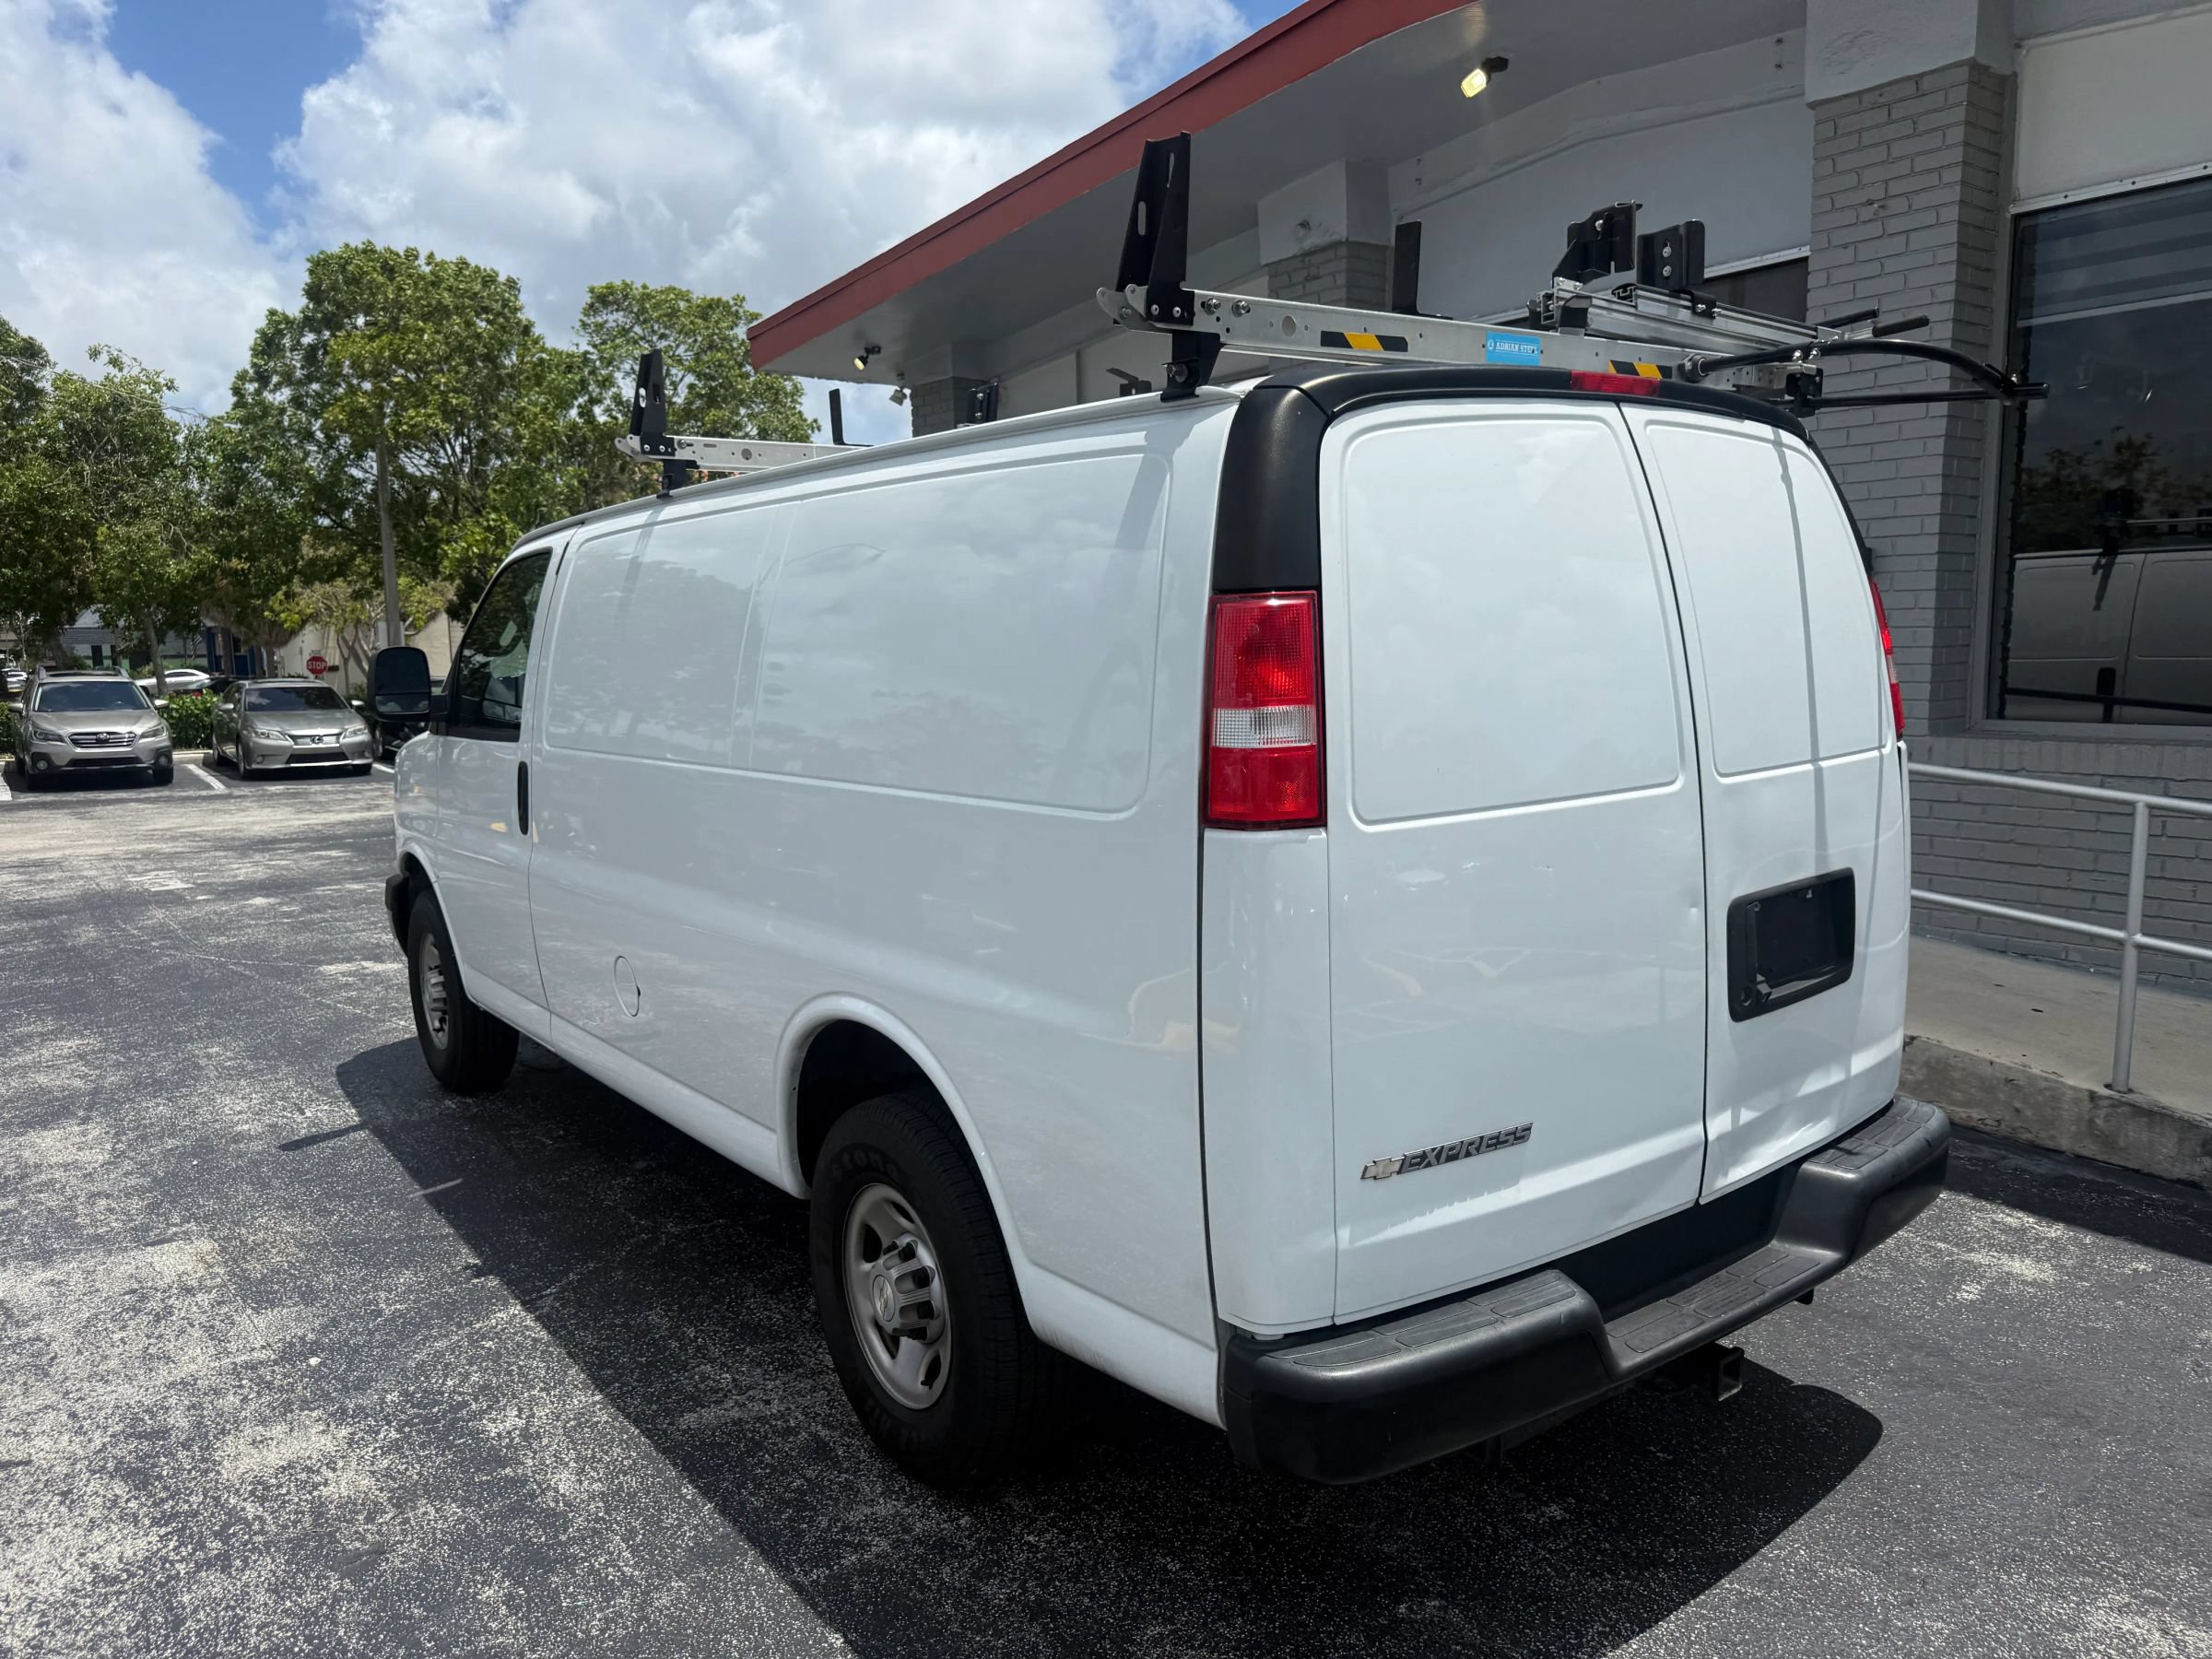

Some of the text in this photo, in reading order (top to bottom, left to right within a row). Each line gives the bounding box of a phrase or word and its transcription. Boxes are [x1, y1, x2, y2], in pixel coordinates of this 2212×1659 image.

[1496, 342, 1520, 352] ADRIAN
[308, 661, 326, 670] STOP
[1398, 1123, 1533, 1174] EXPRESS
